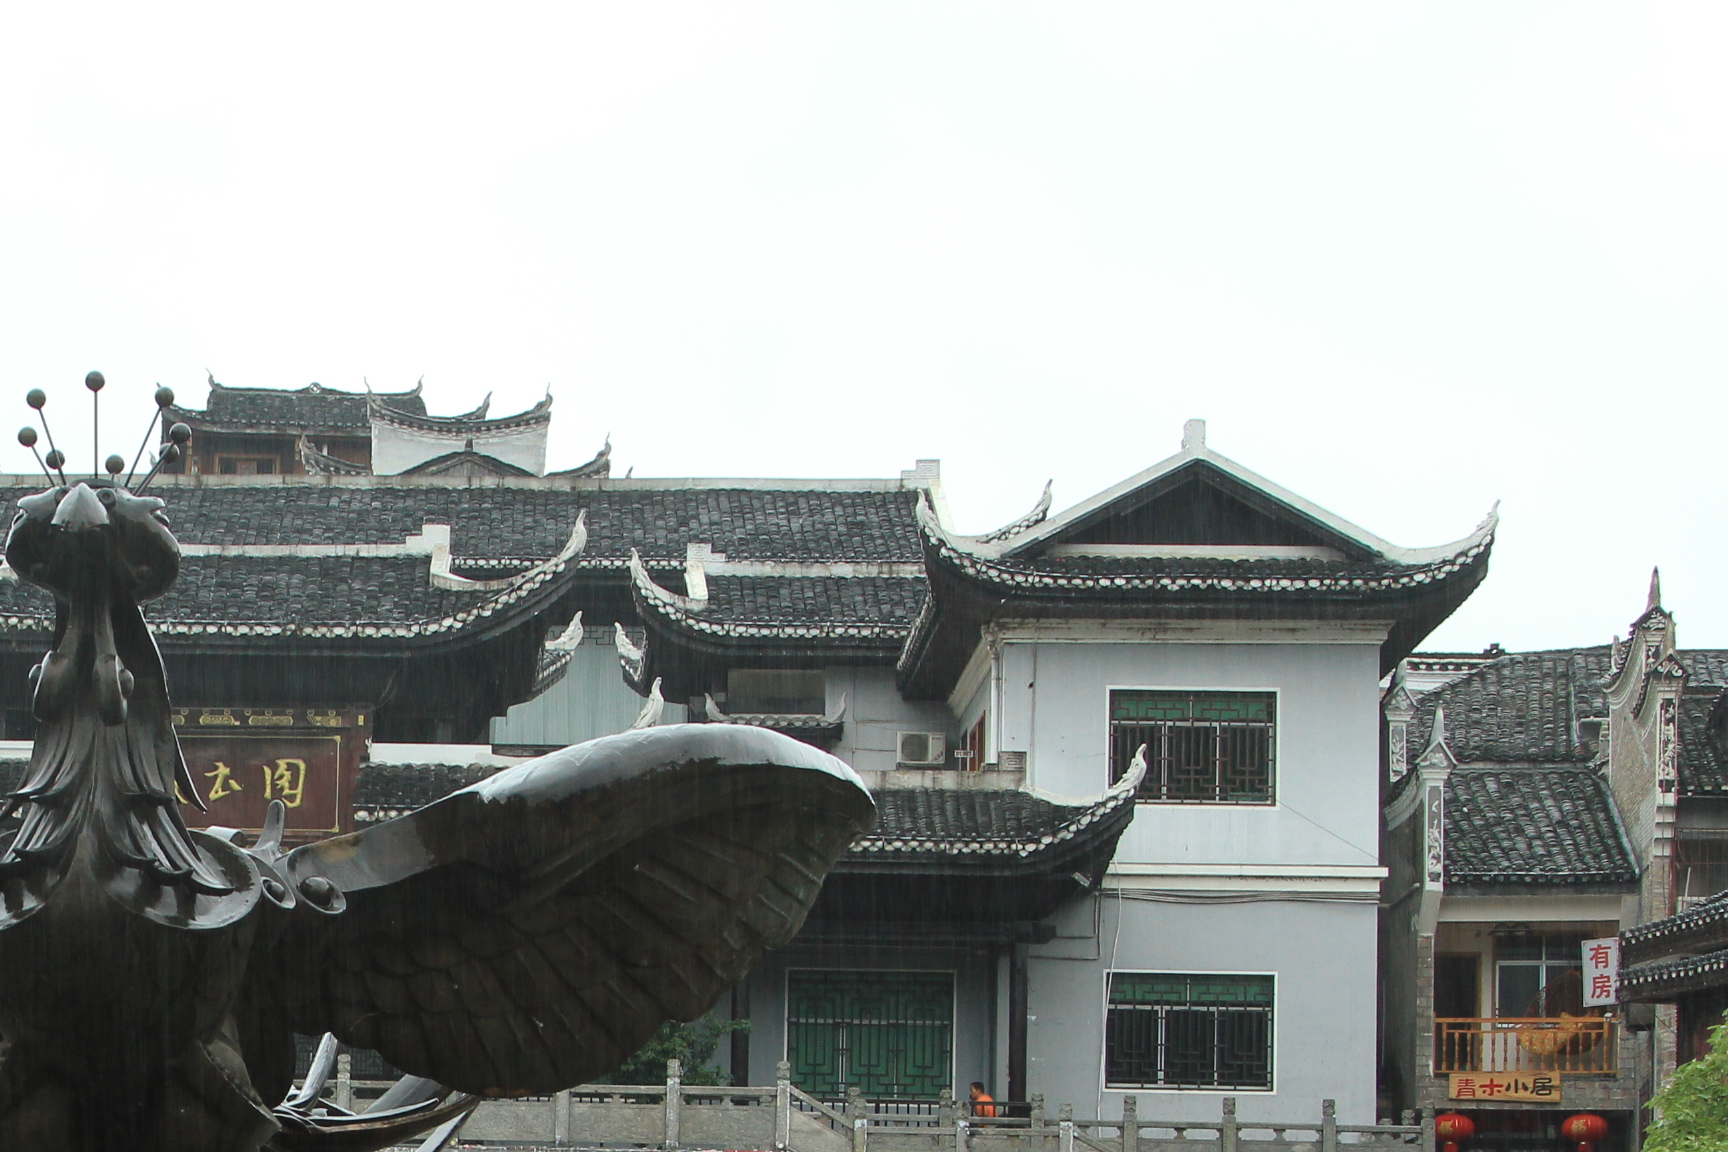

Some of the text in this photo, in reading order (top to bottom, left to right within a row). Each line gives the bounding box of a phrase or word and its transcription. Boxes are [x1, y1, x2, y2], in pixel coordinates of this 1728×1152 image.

[1589, 944, 1612, 999] 有房
[1455, 1077, 1553, 1098] 青木小居
